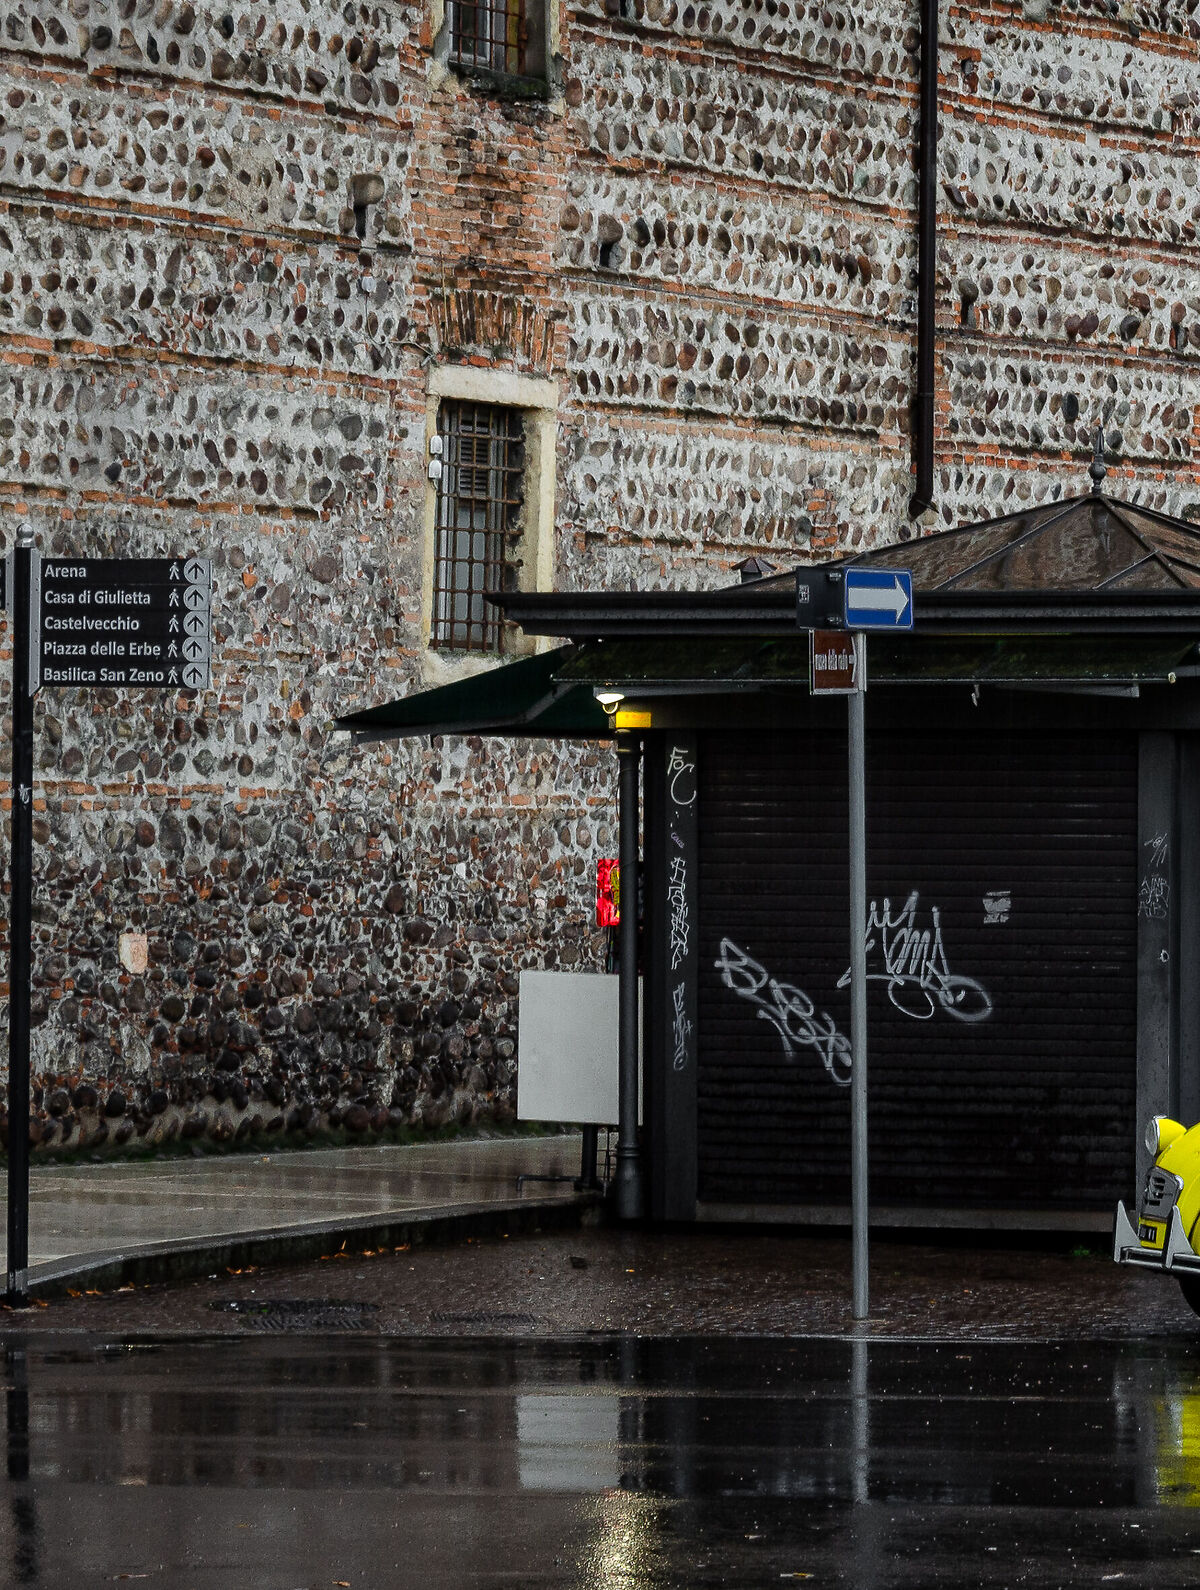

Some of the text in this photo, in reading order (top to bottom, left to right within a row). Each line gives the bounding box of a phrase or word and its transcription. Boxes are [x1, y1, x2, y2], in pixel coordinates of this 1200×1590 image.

[44, 564, 87, 578] Arena
[44, 589, 151, 605] Casa di Giulietta
[44, 615, 140, 631] Castelvecchio
[43, 640, 161, 656] Piazza delle Erbe
[43, 666, 165, 682] Basilica San Zeno
